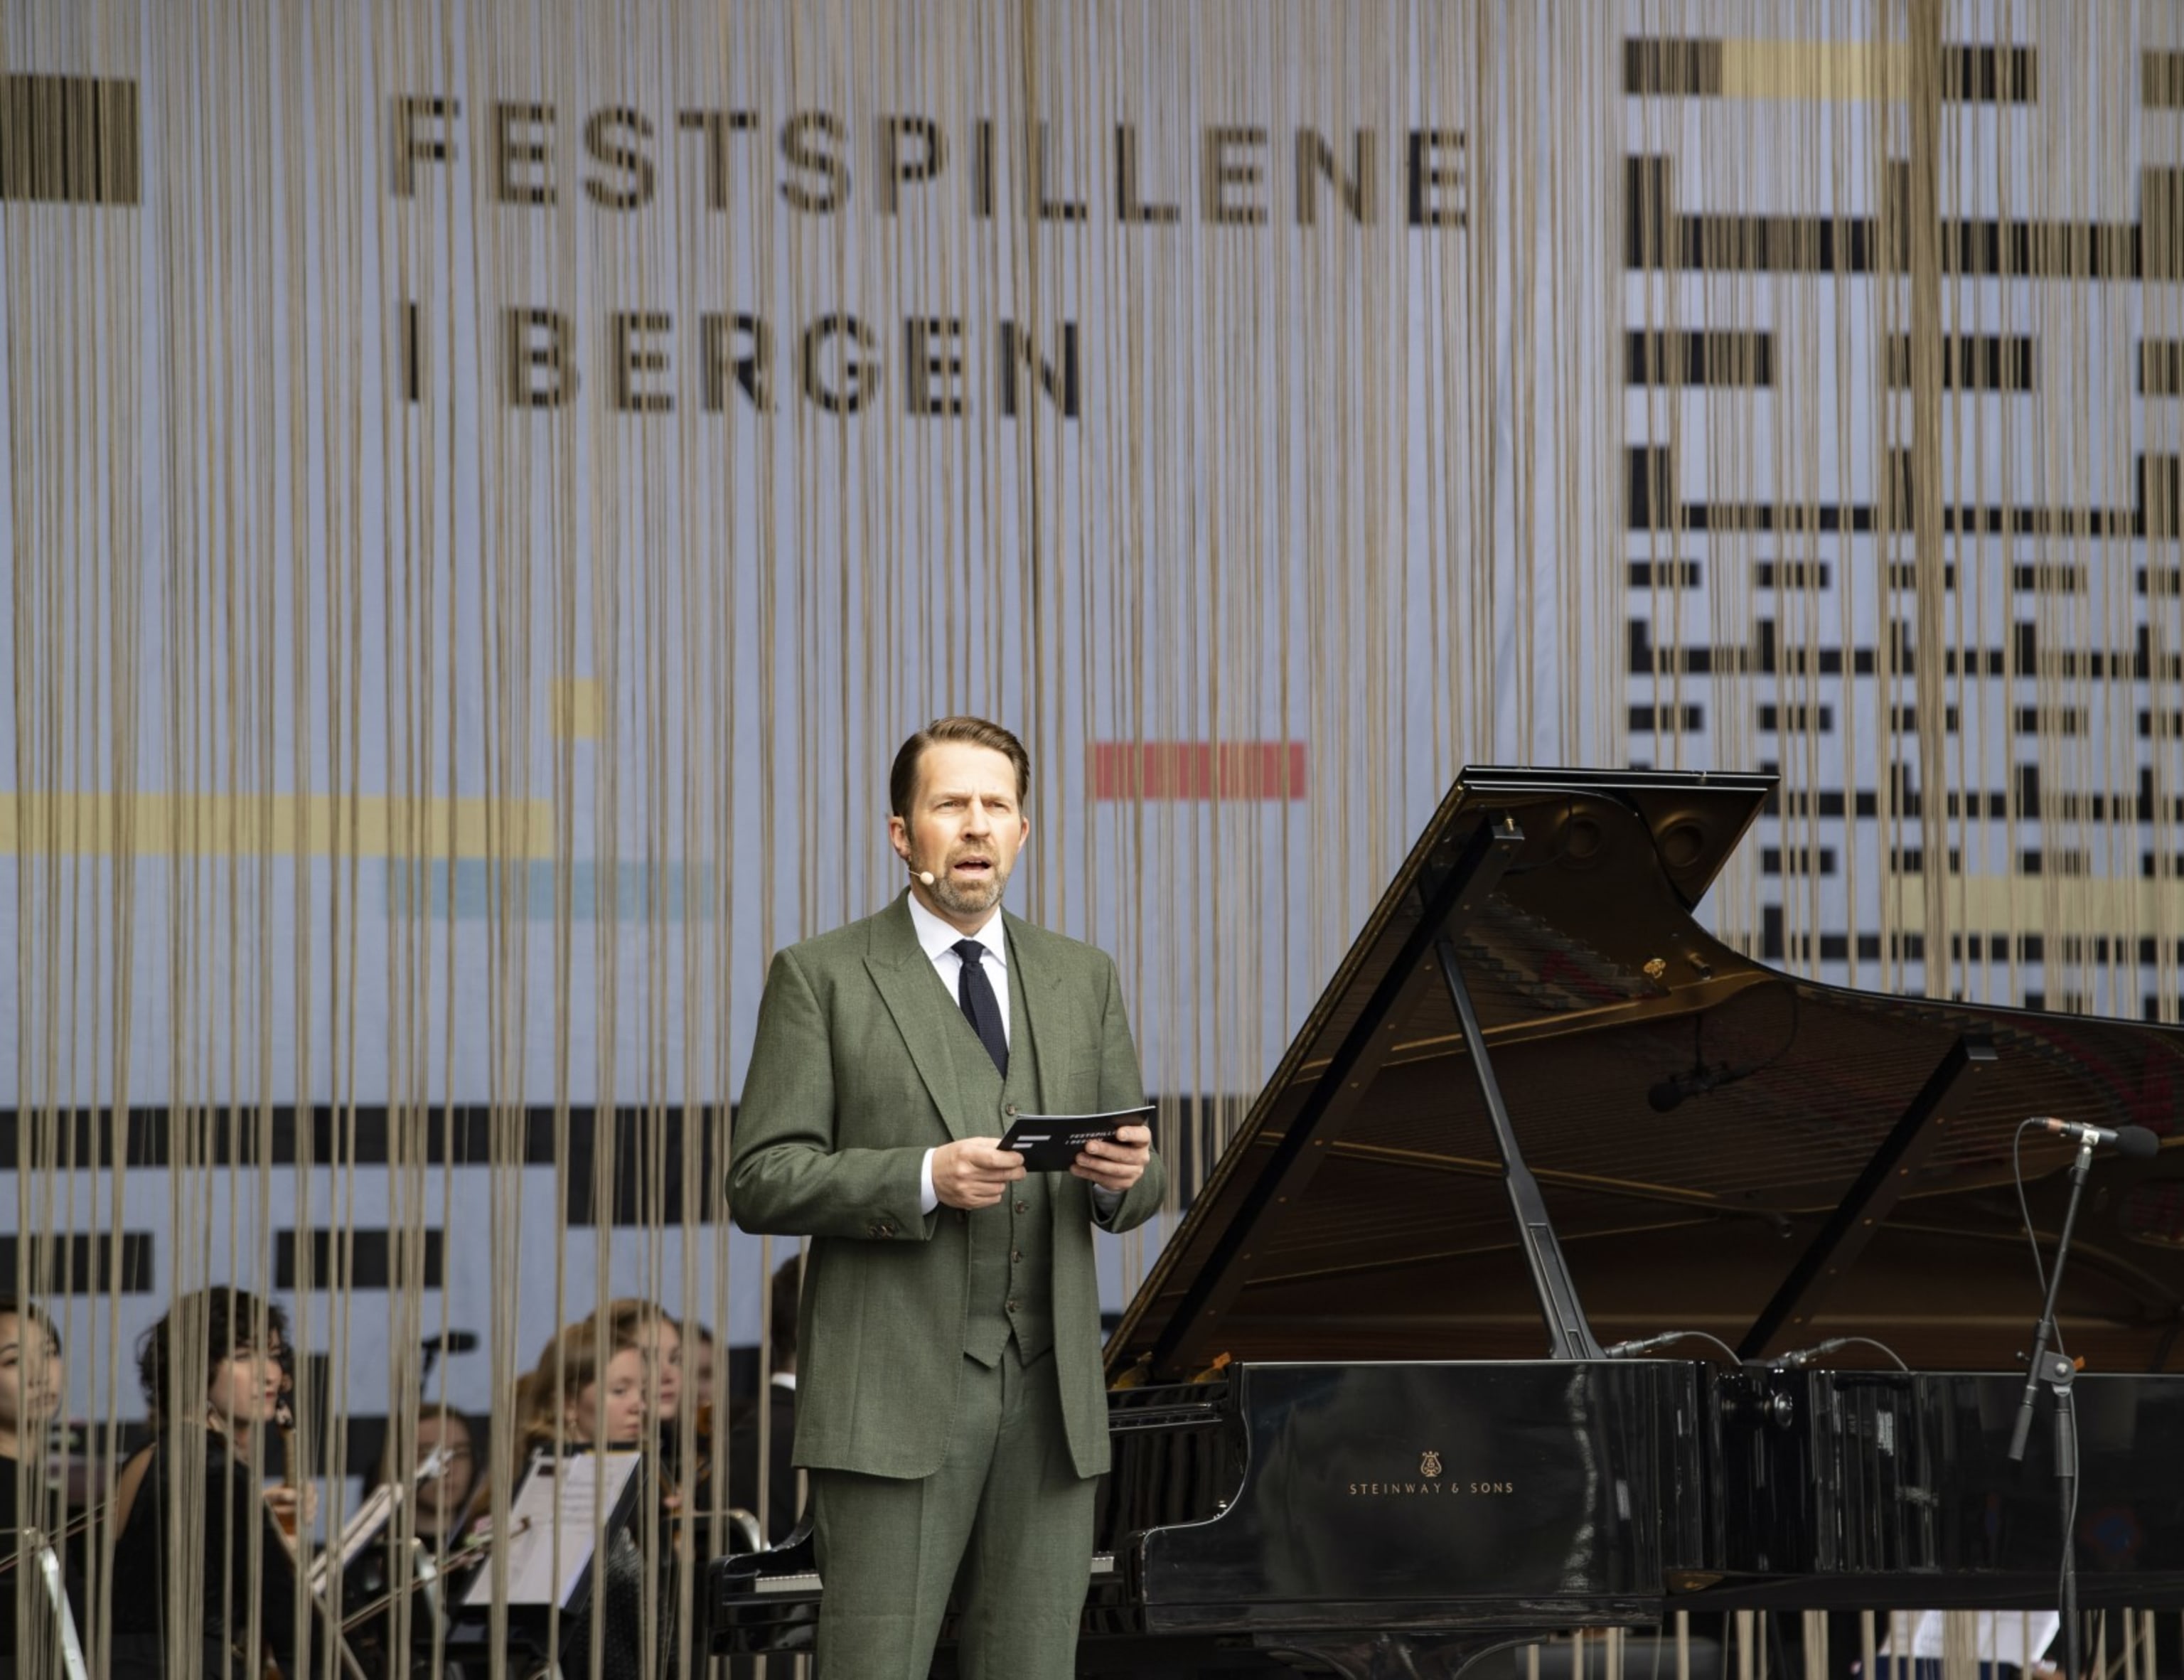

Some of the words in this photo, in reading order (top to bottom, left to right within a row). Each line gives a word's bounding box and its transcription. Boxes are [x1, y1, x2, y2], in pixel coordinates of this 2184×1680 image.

[391, 97, 1467, 226] FESTSPILLENE
[398, 301, 419, 403] I
[504, 306, 1080, 418] BERGEN
[1349, 1482, 1441, 1494] STEINWAY
[1451, 1482, 1459, 1494] &
[1470, 1482, 1513, 1494] SONS
